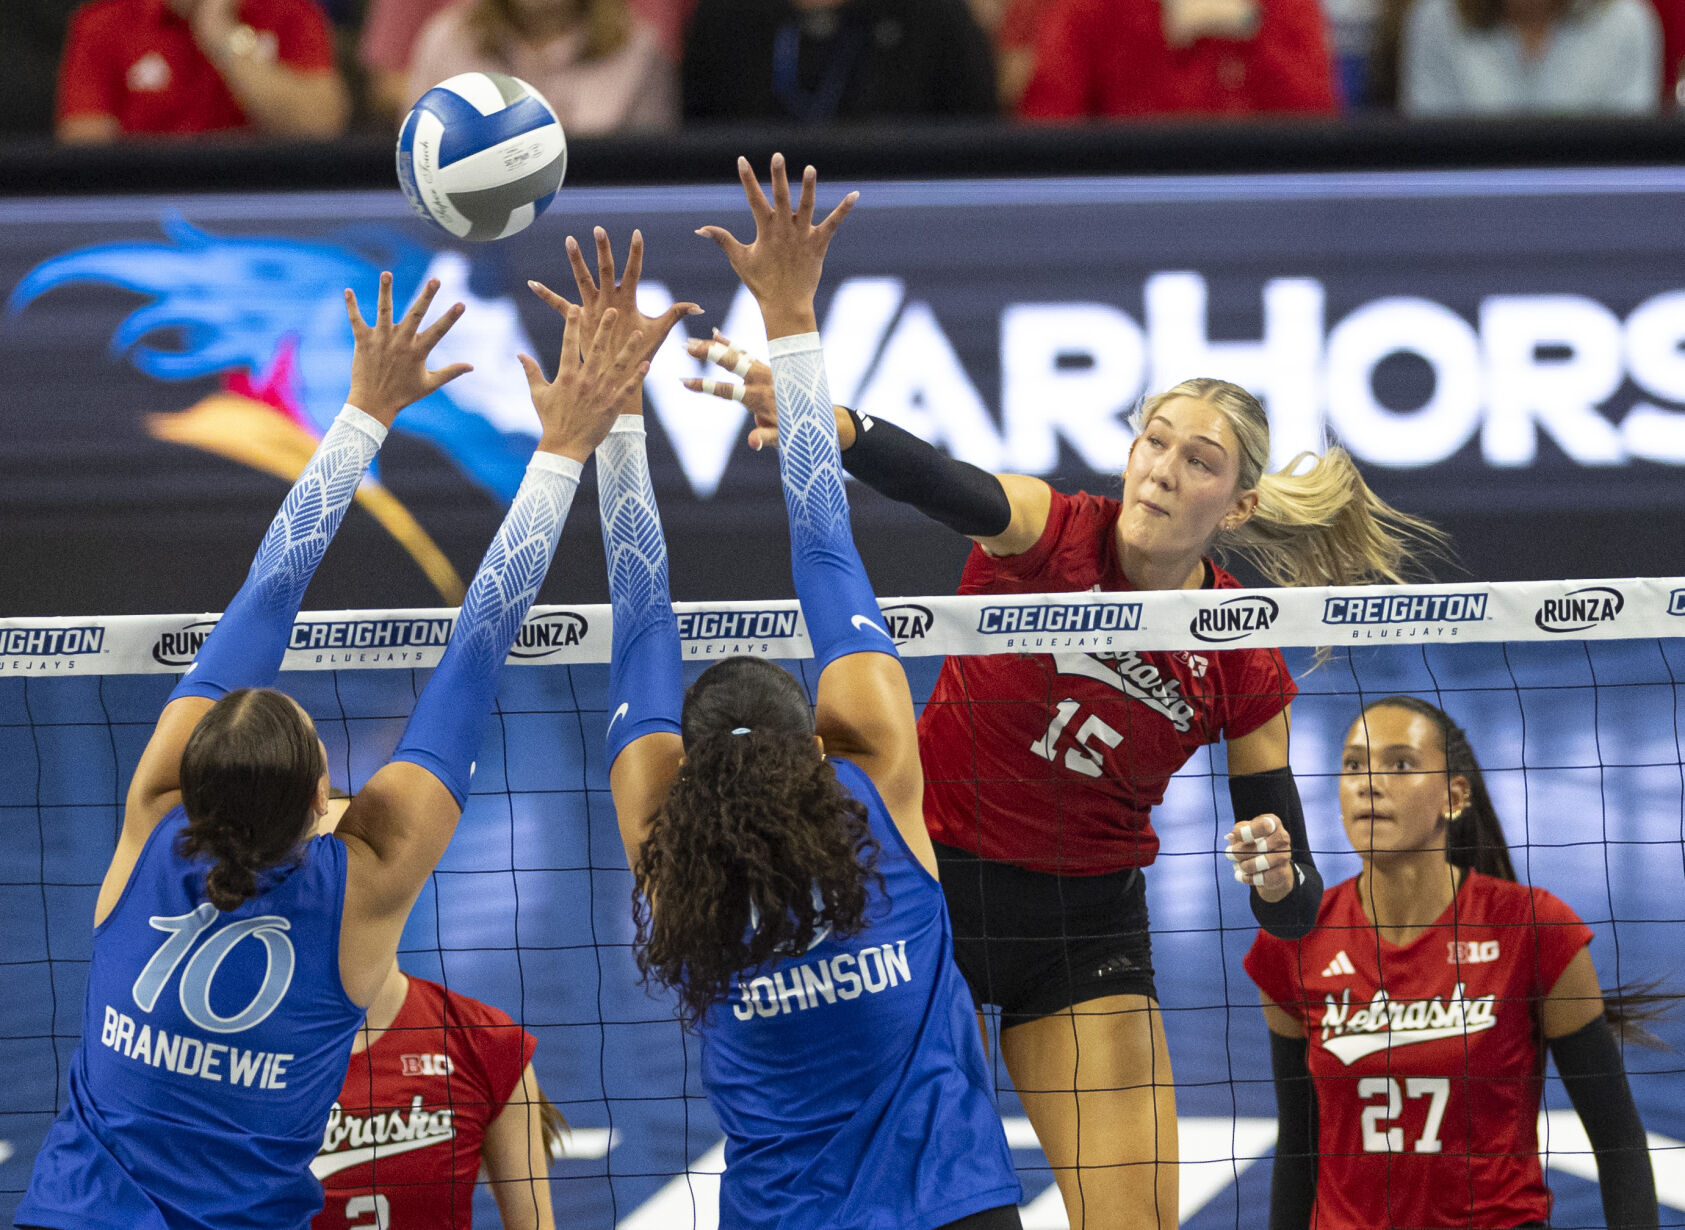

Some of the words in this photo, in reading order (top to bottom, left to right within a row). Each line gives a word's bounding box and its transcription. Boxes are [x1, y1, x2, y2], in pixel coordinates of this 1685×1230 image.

[980, 604, 1142, 632] CREIGHTON
[1200, 607, 1270, 631] RUNZA
[1324, 594, 1487, 622] CREIGHTON
[1544, 597, 1614, 621] RUNZA
[162, 632, 210, 655] RUN
[289, 619, 450, 649] CREIGHTON
[1007, 637, 1113, 647] BLUEJAYS
[1352, 628, 1458, 638] BLUEJAYS
[316, 652, 422, 663] BLUEJAYS
[691, 644, 768, 655] UEJAYS
[1096, 651, 1194, 732] raska
[1030, 698, 1124, 778] 15
[132, 902, 295, 1033] 10
[733, 940, 912, 1021] JOHNSON
[1321, 982, 1497, 1042] Nebraska
[101, 1005, 294, 1089] BRANDEWIE
[1357, 1077, 1450, 1153] 27
